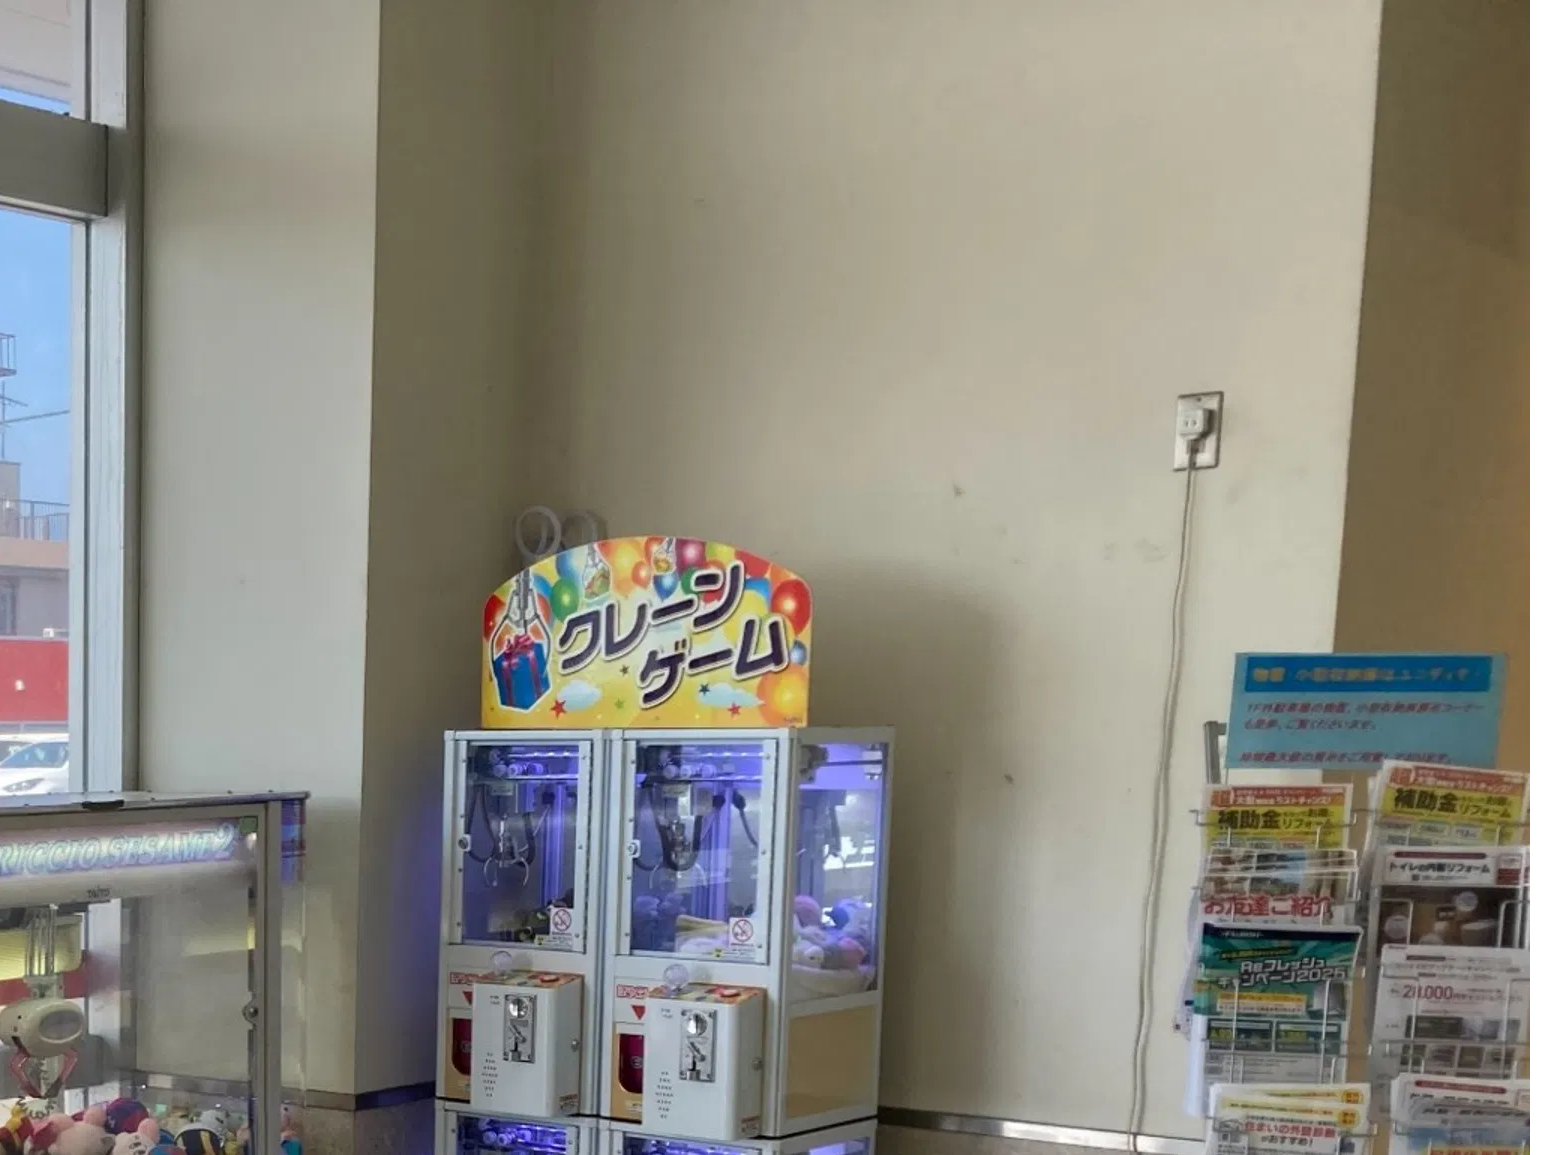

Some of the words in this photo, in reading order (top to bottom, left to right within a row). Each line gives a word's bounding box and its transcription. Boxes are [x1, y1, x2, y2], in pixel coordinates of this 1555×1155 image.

[558, 563, 743, 671] クレーン
[640, 616, 788, 706] ゲーム
